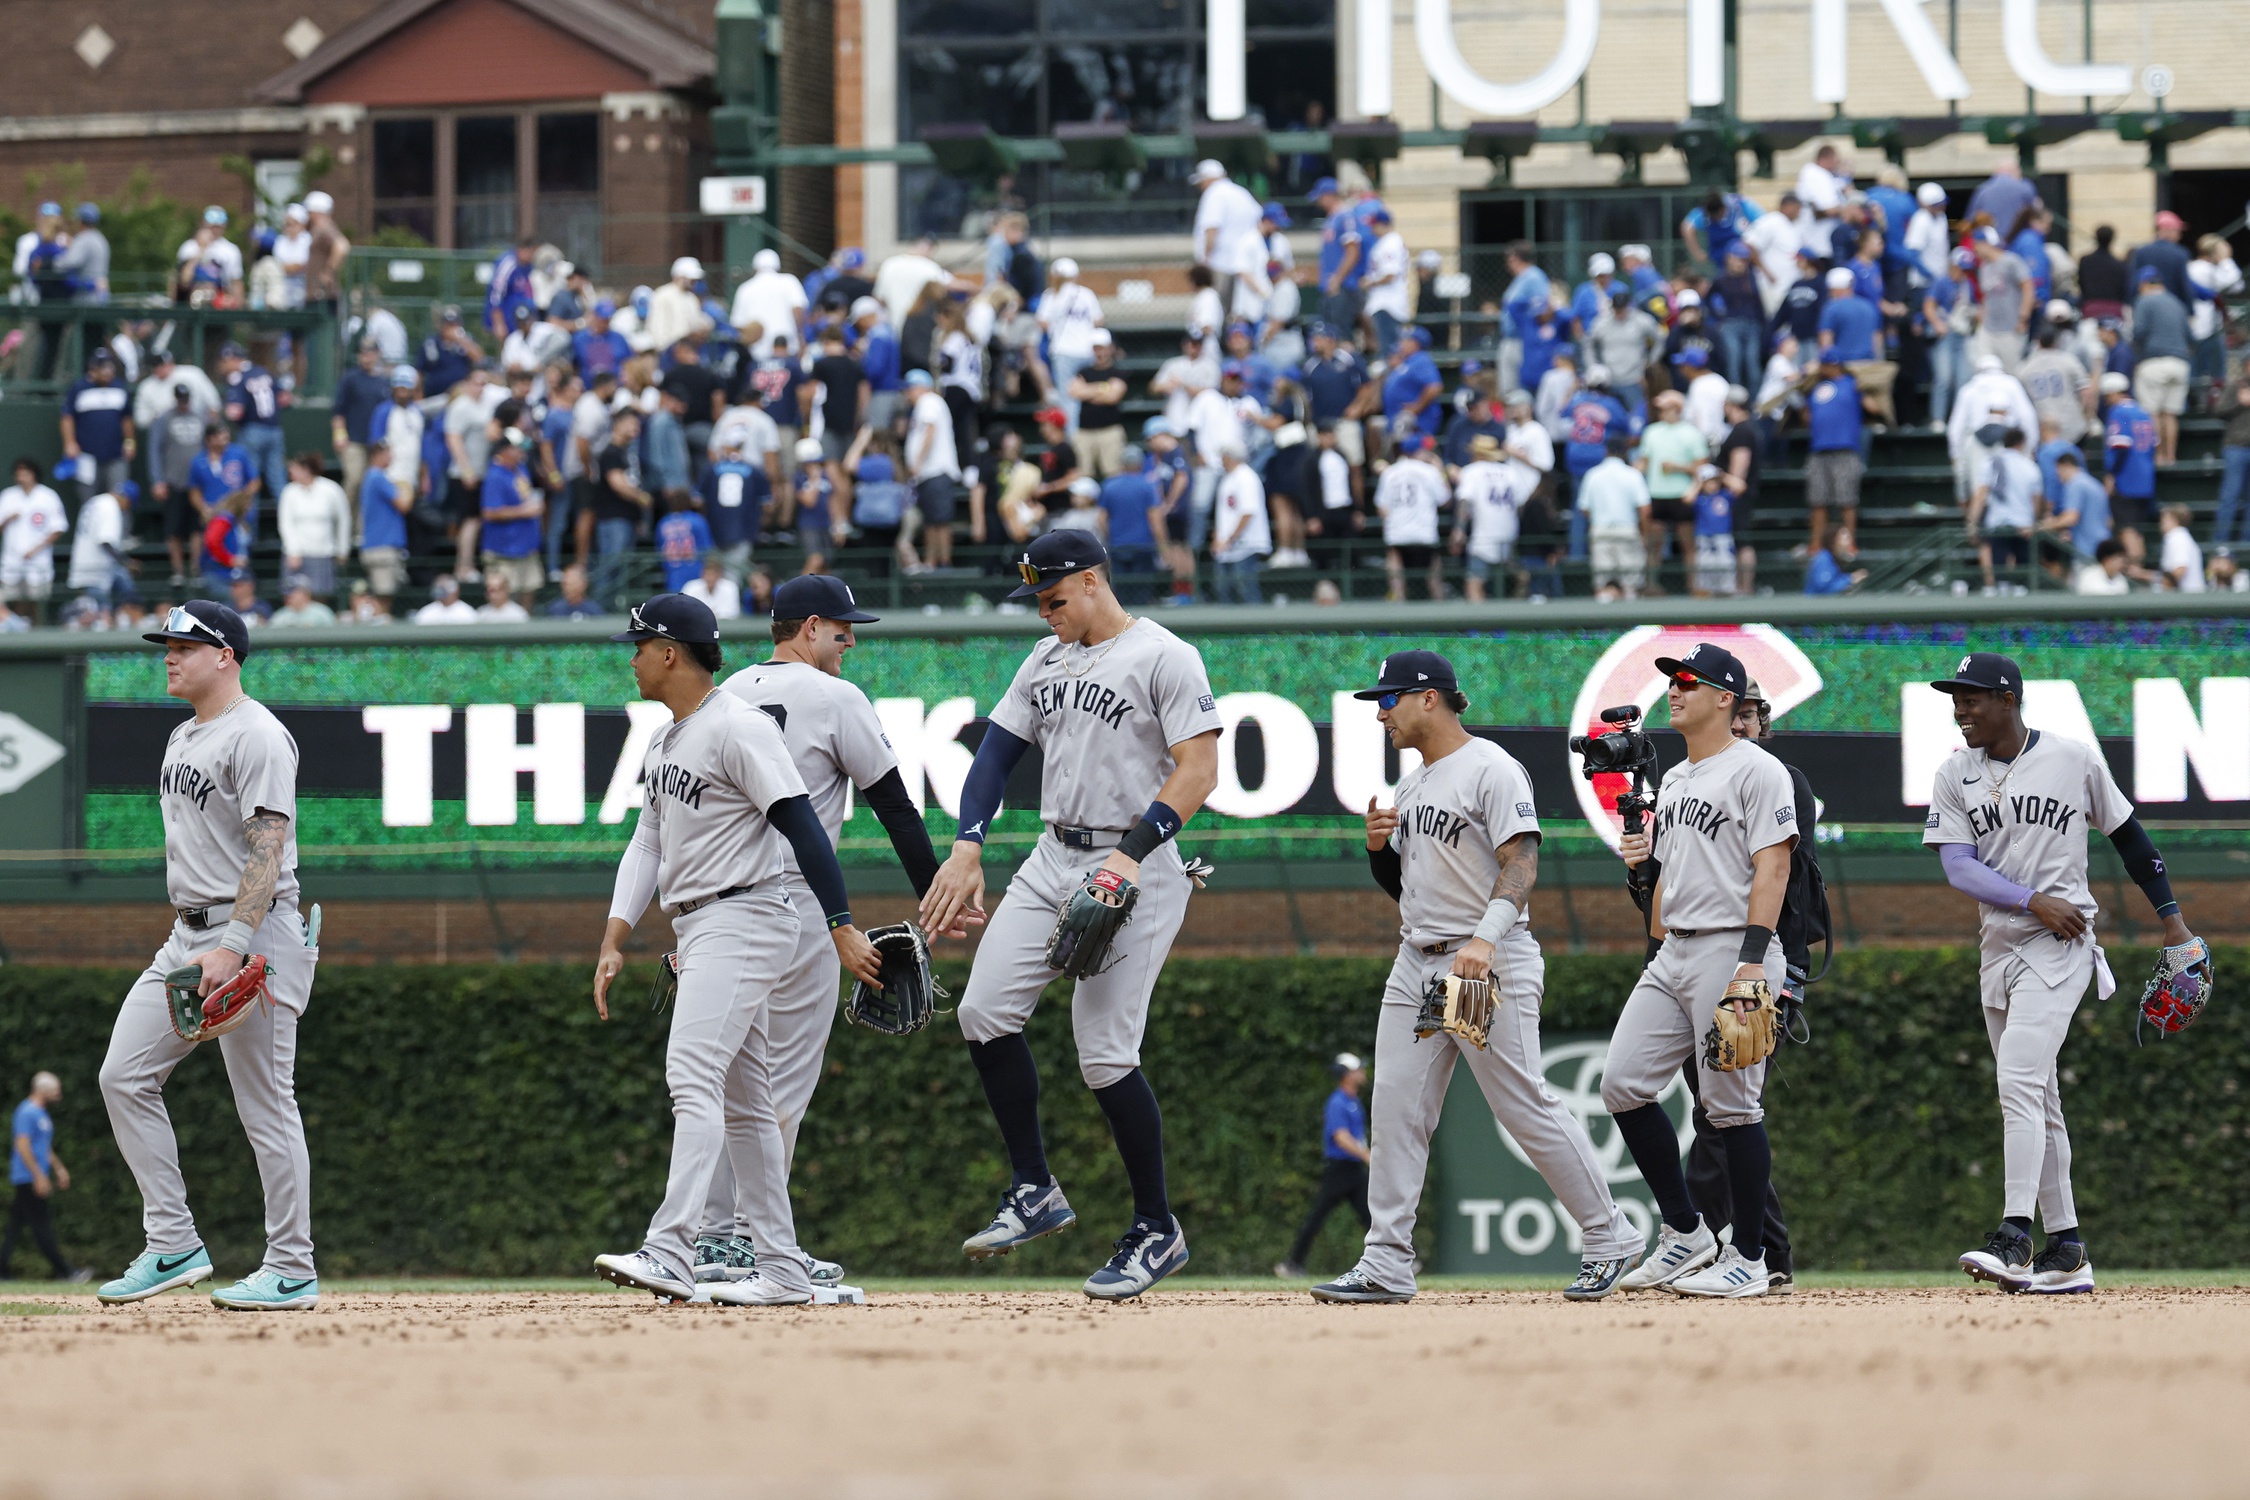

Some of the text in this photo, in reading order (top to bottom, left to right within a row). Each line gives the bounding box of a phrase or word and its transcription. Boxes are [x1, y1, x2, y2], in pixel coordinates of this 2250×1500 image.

[1074, 680, 1134, 731] YORK
[362, 697, 1003, 827] THK
[174, 763, 216, 812] YORK
[646, 763, 711, 812] EW YORK
[1080, 834, 1090, 844] 99
[1416, 804, 1469, 849] YORK
[1657, 796, 1730, 842] EW YORK
[1967, 795, 2077, 840] EW YORK
[1434, 943, 1443, 952] 25
